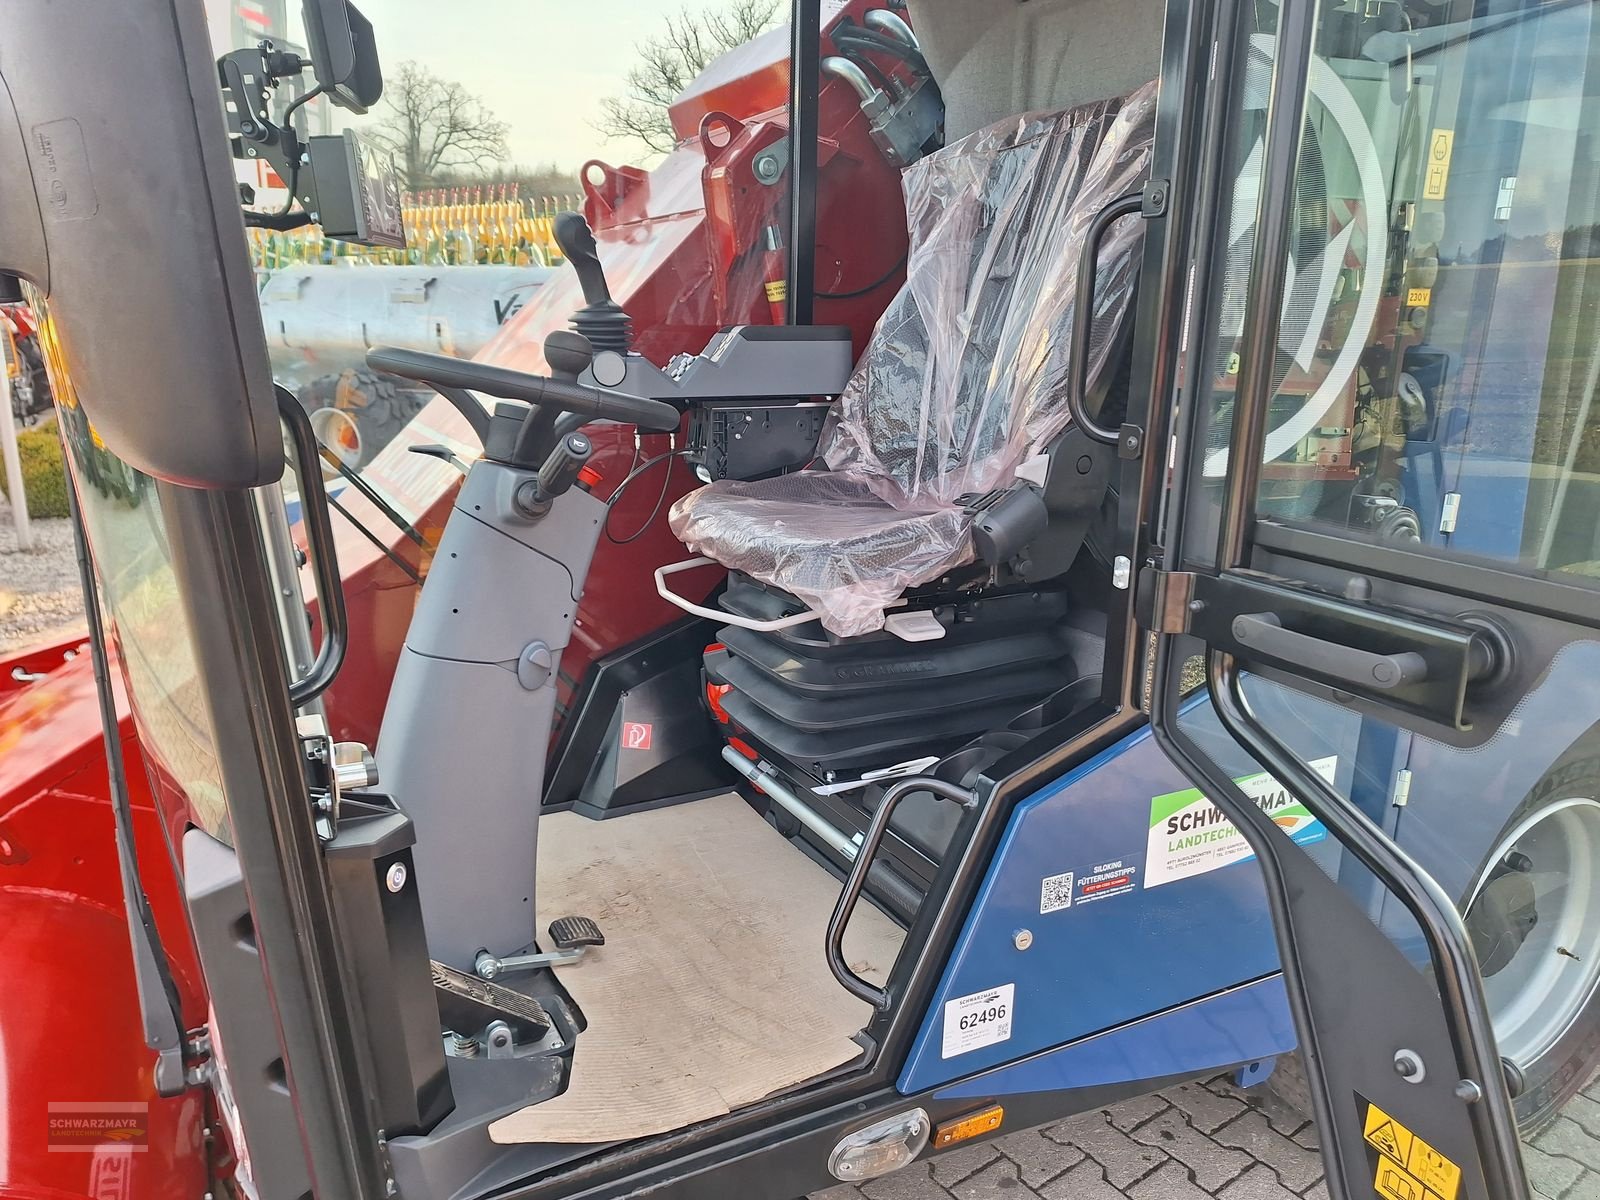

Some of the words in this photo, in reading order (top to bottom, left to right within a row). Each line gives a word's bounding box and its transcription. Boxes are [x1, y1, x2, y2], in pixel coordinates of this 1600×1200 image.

[1094, 861, 1121, 873] SILOKING
[1077, 866, 1136, 886] FÜTTERUNGSTIPPS
[959, 991, 997, 1004] SCHWARZMAYR
[960, 1004, 1006, 1030] 62496
